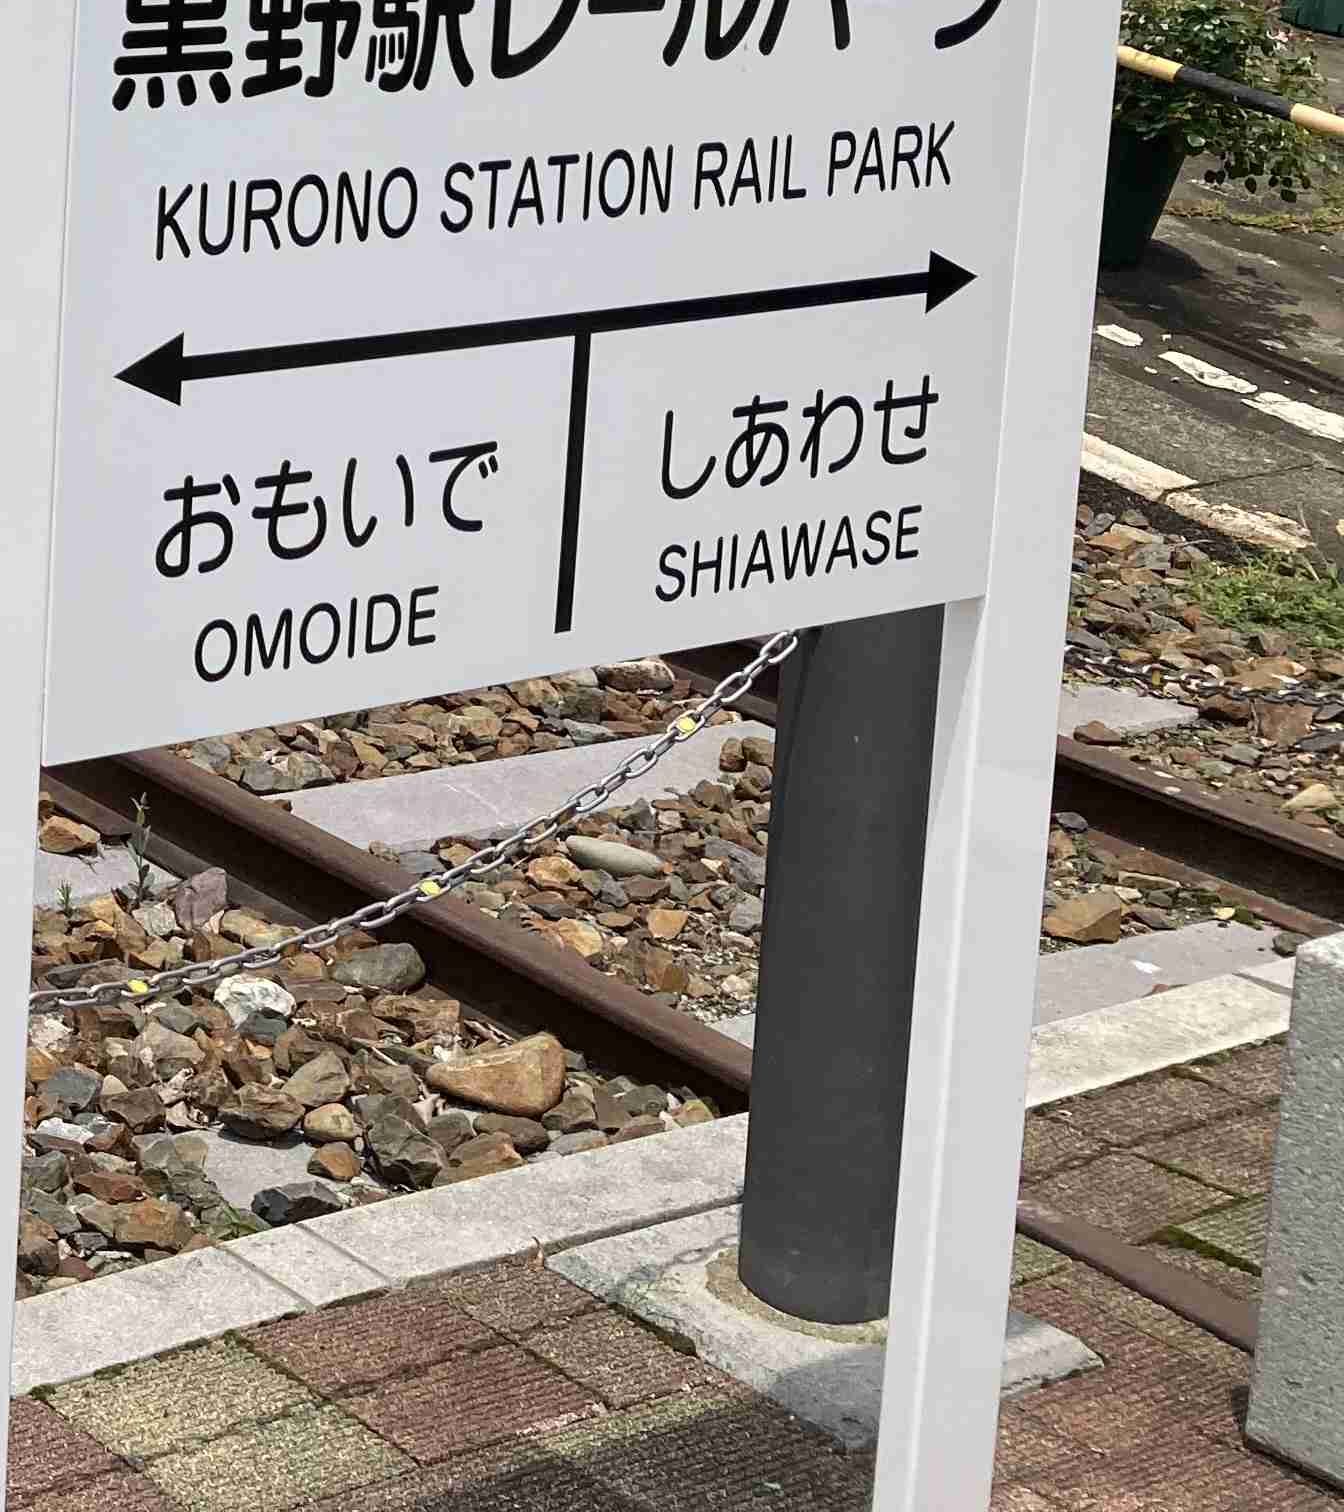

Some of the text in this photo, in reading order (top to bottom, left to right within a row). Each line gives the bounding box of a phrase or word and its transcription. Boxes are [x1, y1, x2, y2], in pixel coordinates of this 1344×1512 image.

[155, 120, 955, 262] KURONO STATION RAIL PARK
[661, 375, 939, 500] しあわせ
[155, 440, 499, 578] おもいで
[655, 504, 923, 602] SHIAWASE
[194, 585, 440, 683] OMOIDE
